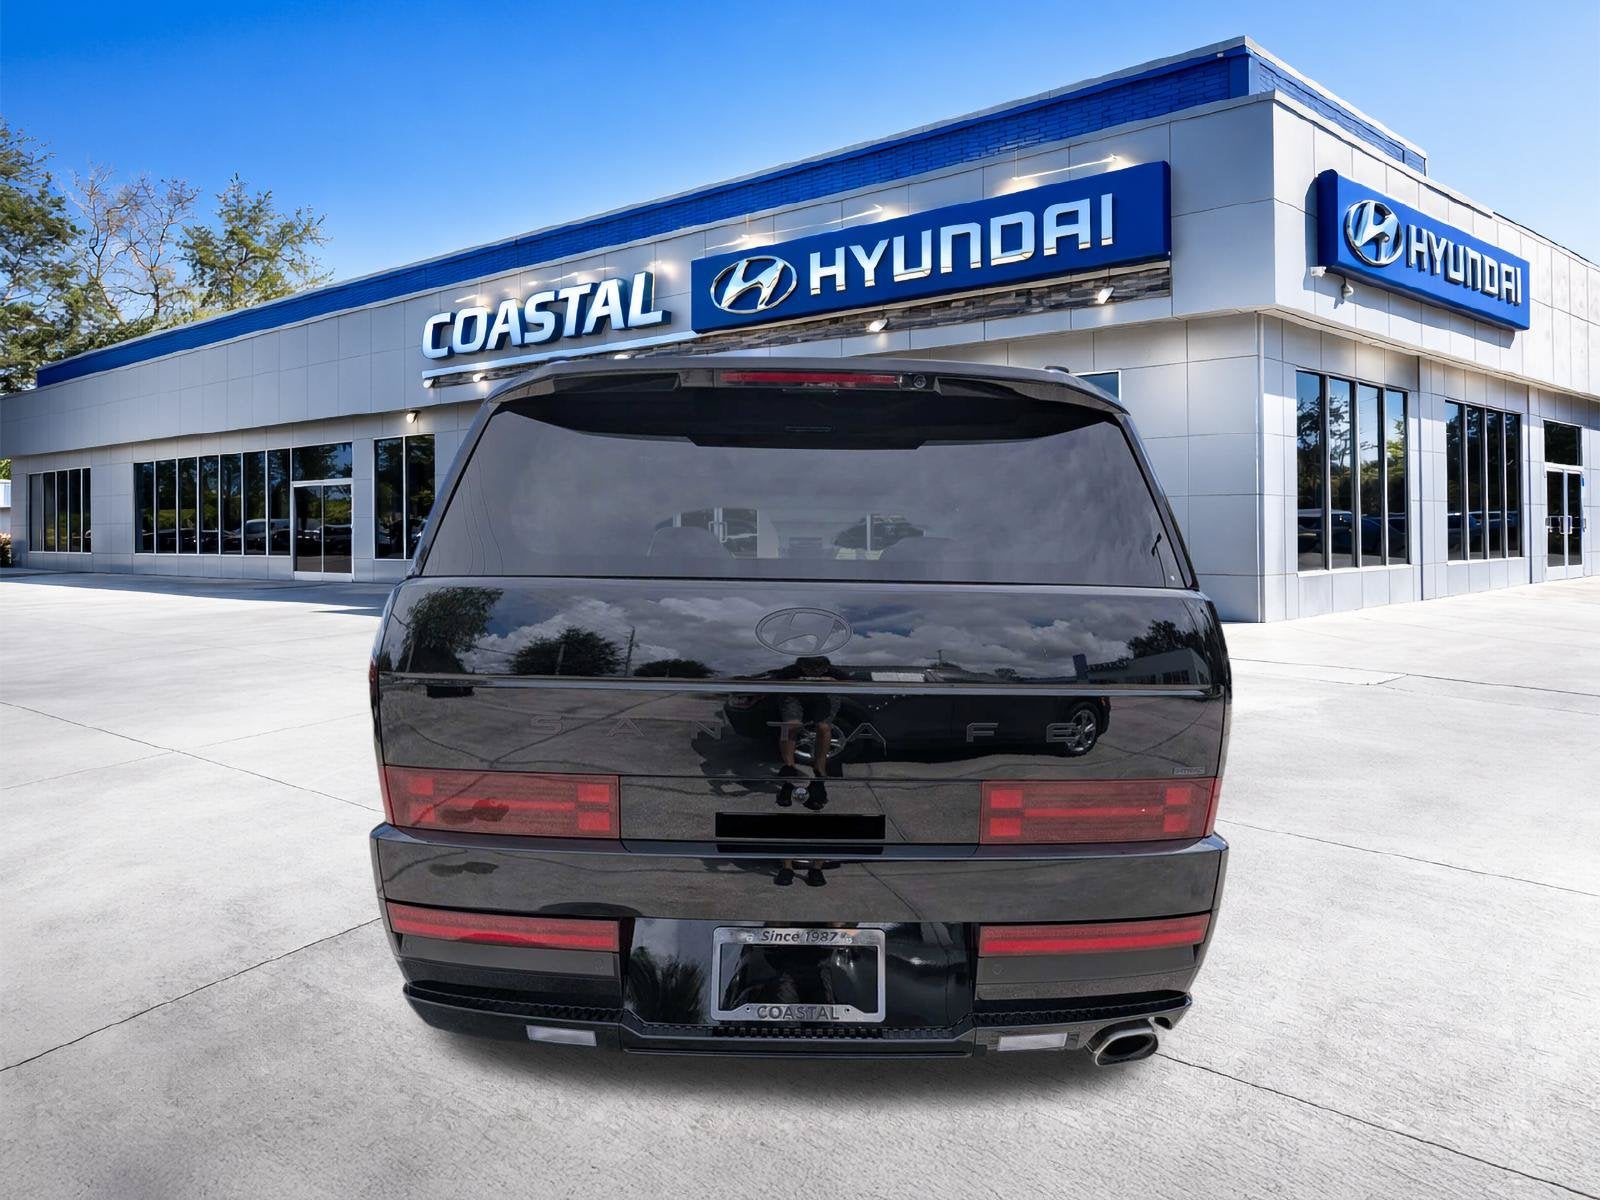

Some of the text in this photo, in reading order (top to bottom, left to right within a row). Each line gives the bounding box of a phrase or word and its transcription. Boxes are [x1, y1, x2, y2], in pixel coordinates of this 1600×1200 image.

[809, 193, 1114, 295] HYUNDAI
[1407, 224, 1522, 306] HYUNDAI
[422, 271, 665, 361] COASTAL
[530, 713, 1078, 744] SANTA FE
[761, 931, 838, 942] Since 1987
[757, 1005, 840, 1020] COASTAL
